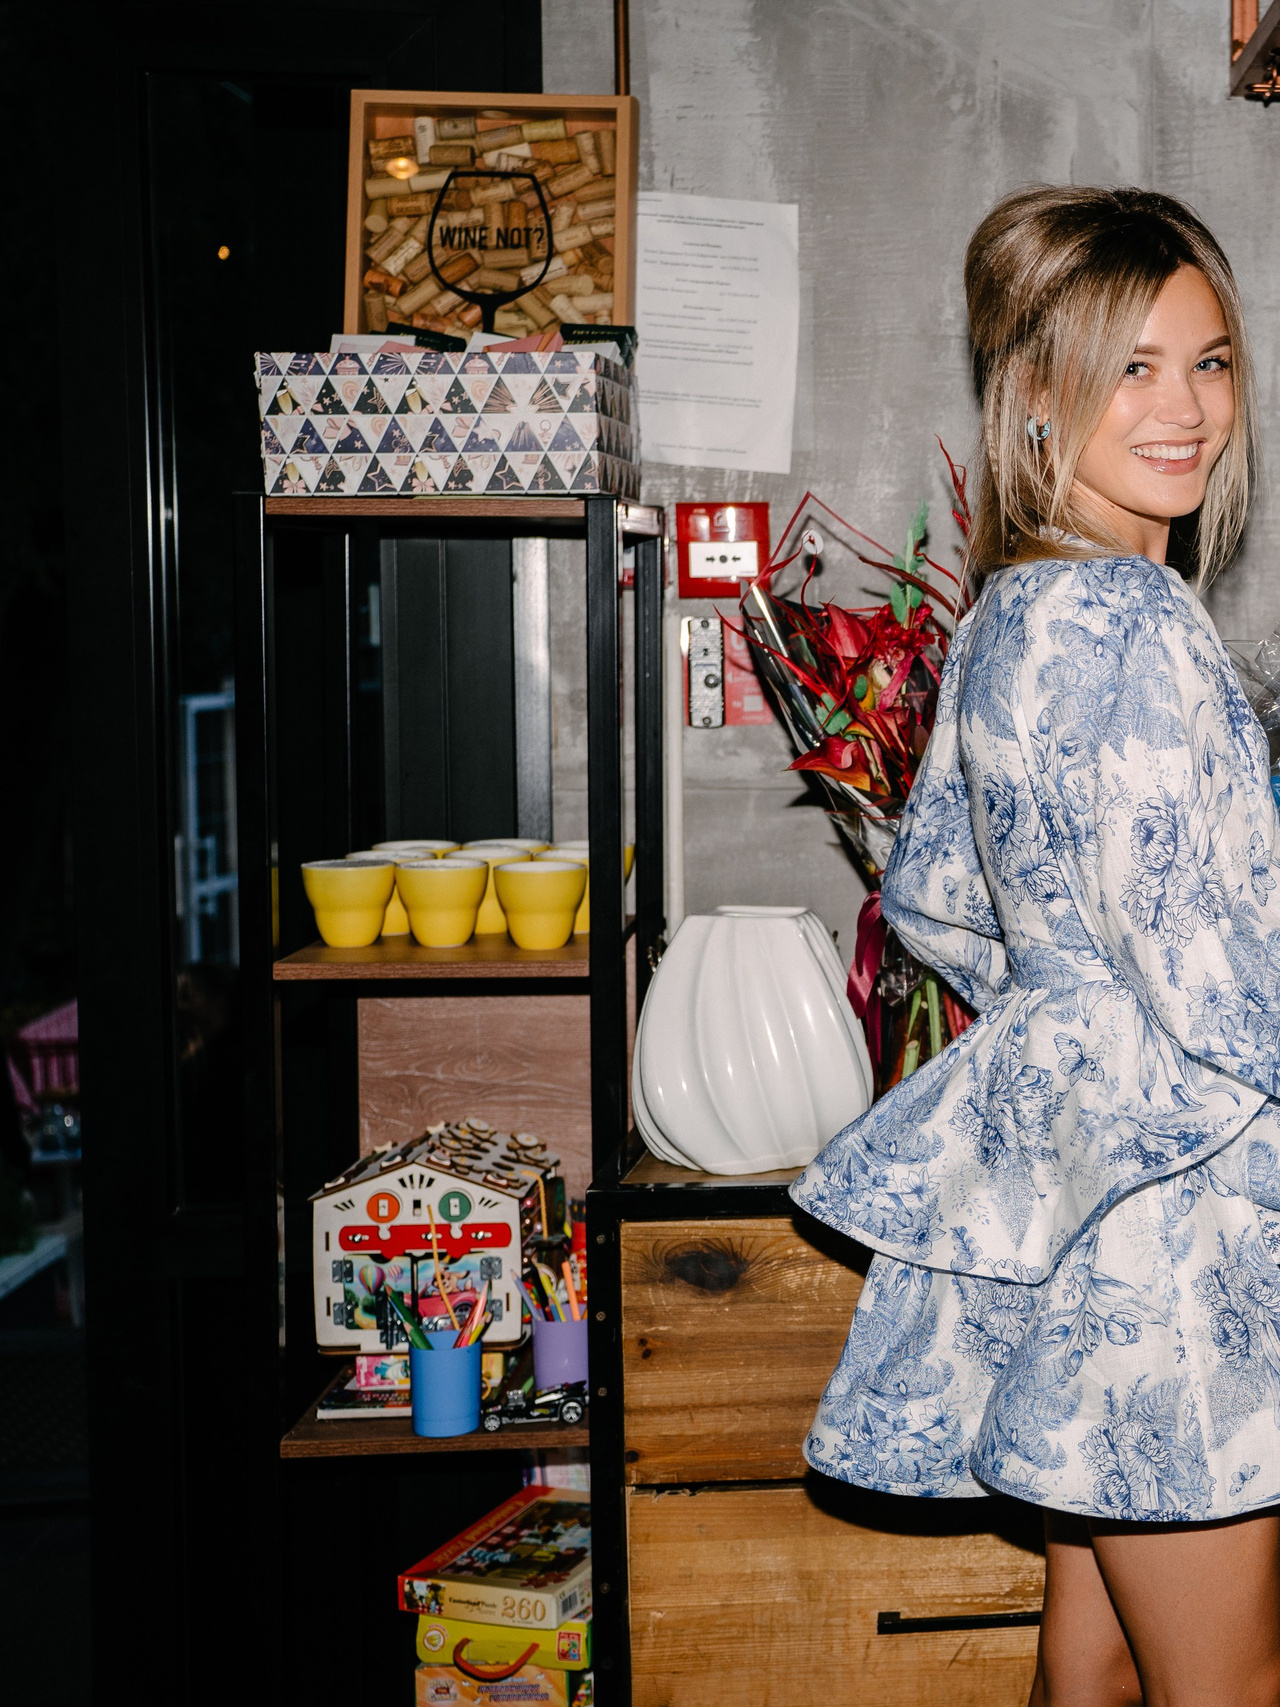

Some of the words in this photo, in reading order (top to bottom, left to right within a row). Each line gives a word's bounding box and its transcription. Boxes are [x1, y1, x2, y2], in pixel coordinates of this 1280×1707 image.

[439, 226, 488, 250] WINE
[496, 227, 544, 250] NOT?
[501, 1595, 546, 1621] 260
